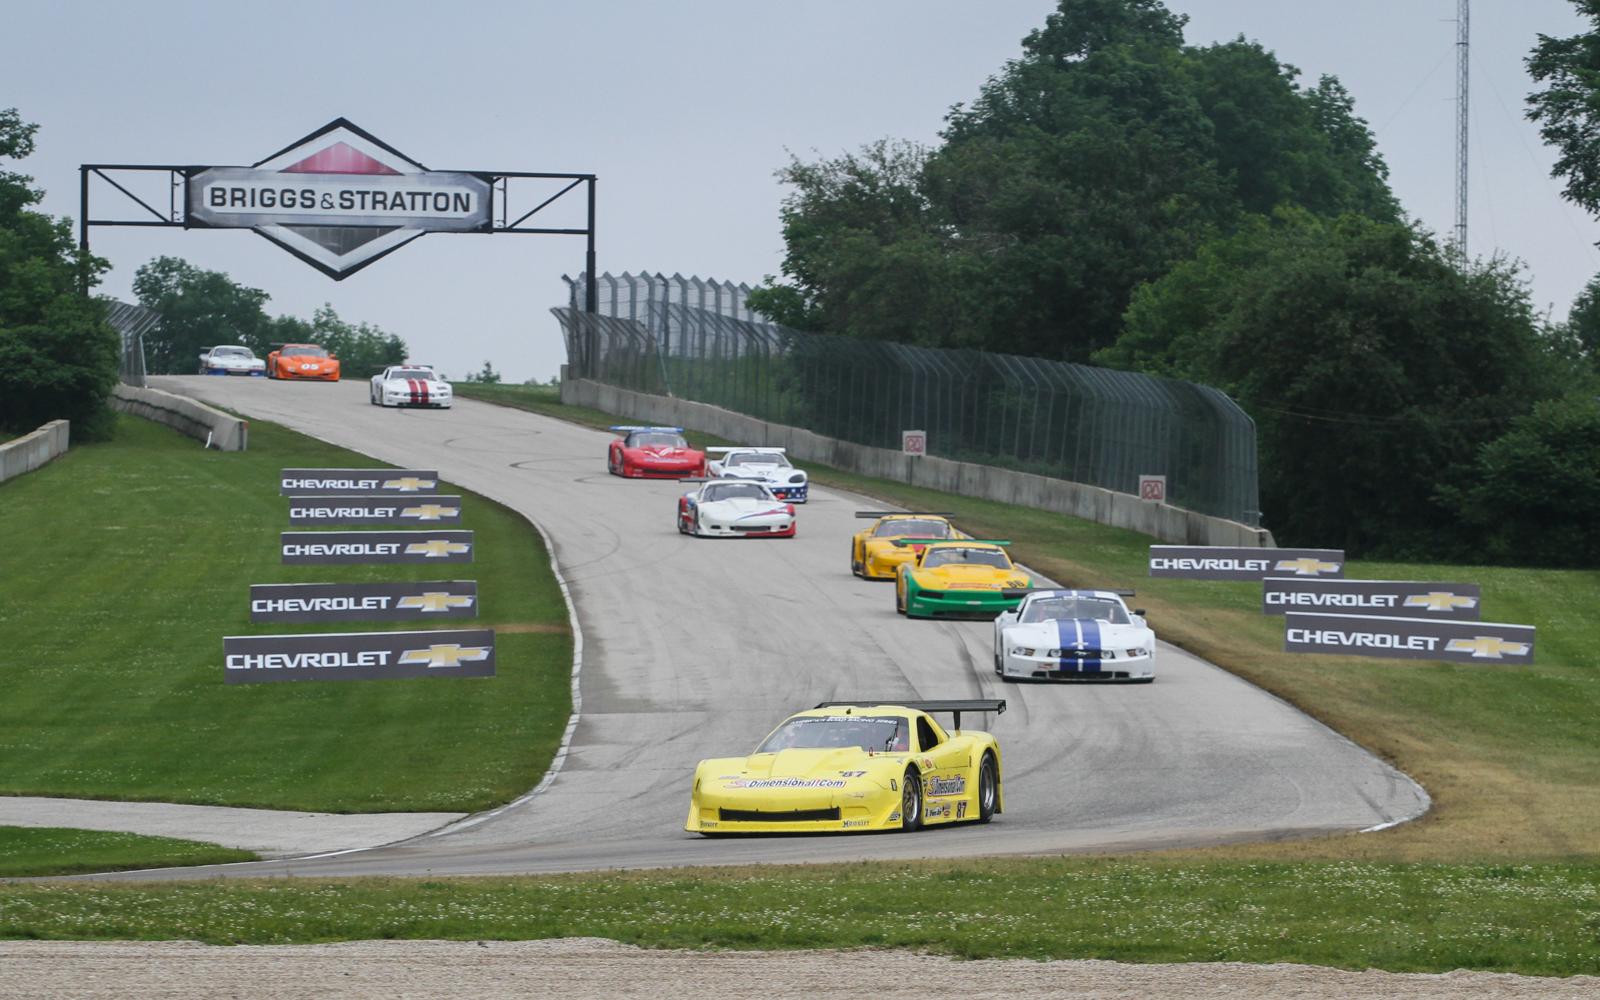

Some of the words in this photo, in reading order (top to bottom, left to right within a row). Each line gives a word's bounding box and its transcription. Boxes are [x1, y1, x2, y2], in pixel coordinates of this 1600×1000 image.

[282, 478, 379, 490] CHEVROLET
[290, 507, 397, 519] CHEVROLET
[283, 543, 400, 556] CHEVROLET
[1150, 558, 1270, 572] CHEVROLET
[252, 596, 392, 613] CHEVROLET
[1265, 592, 1399, 608] CHEVROLET
[1287, 628, 1440, 651] CHEVROLET
[225, 650, 392, 671] CHEVROLET
[956, 800, 968, 818] 87
